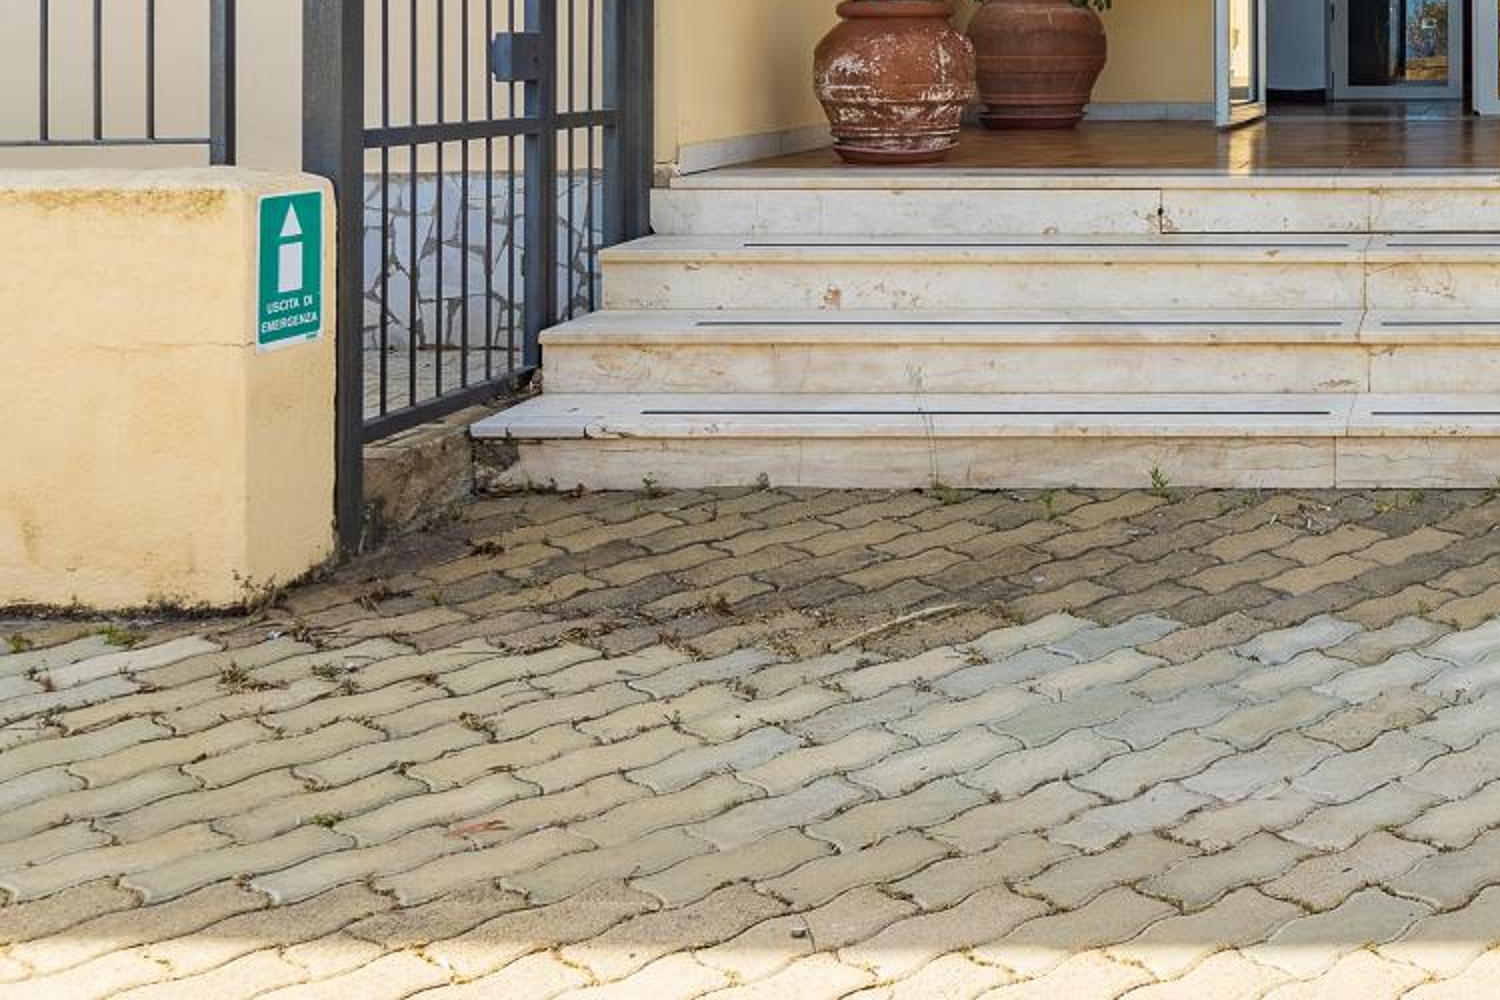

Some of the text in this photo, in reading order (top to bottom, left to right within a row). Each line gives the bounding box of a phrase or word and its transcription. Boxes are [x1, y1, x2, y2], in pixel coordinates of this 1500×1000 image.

[266, 294, 313, 314] USCITA DI
[262, 312, 318, 333] EMERGENZA
